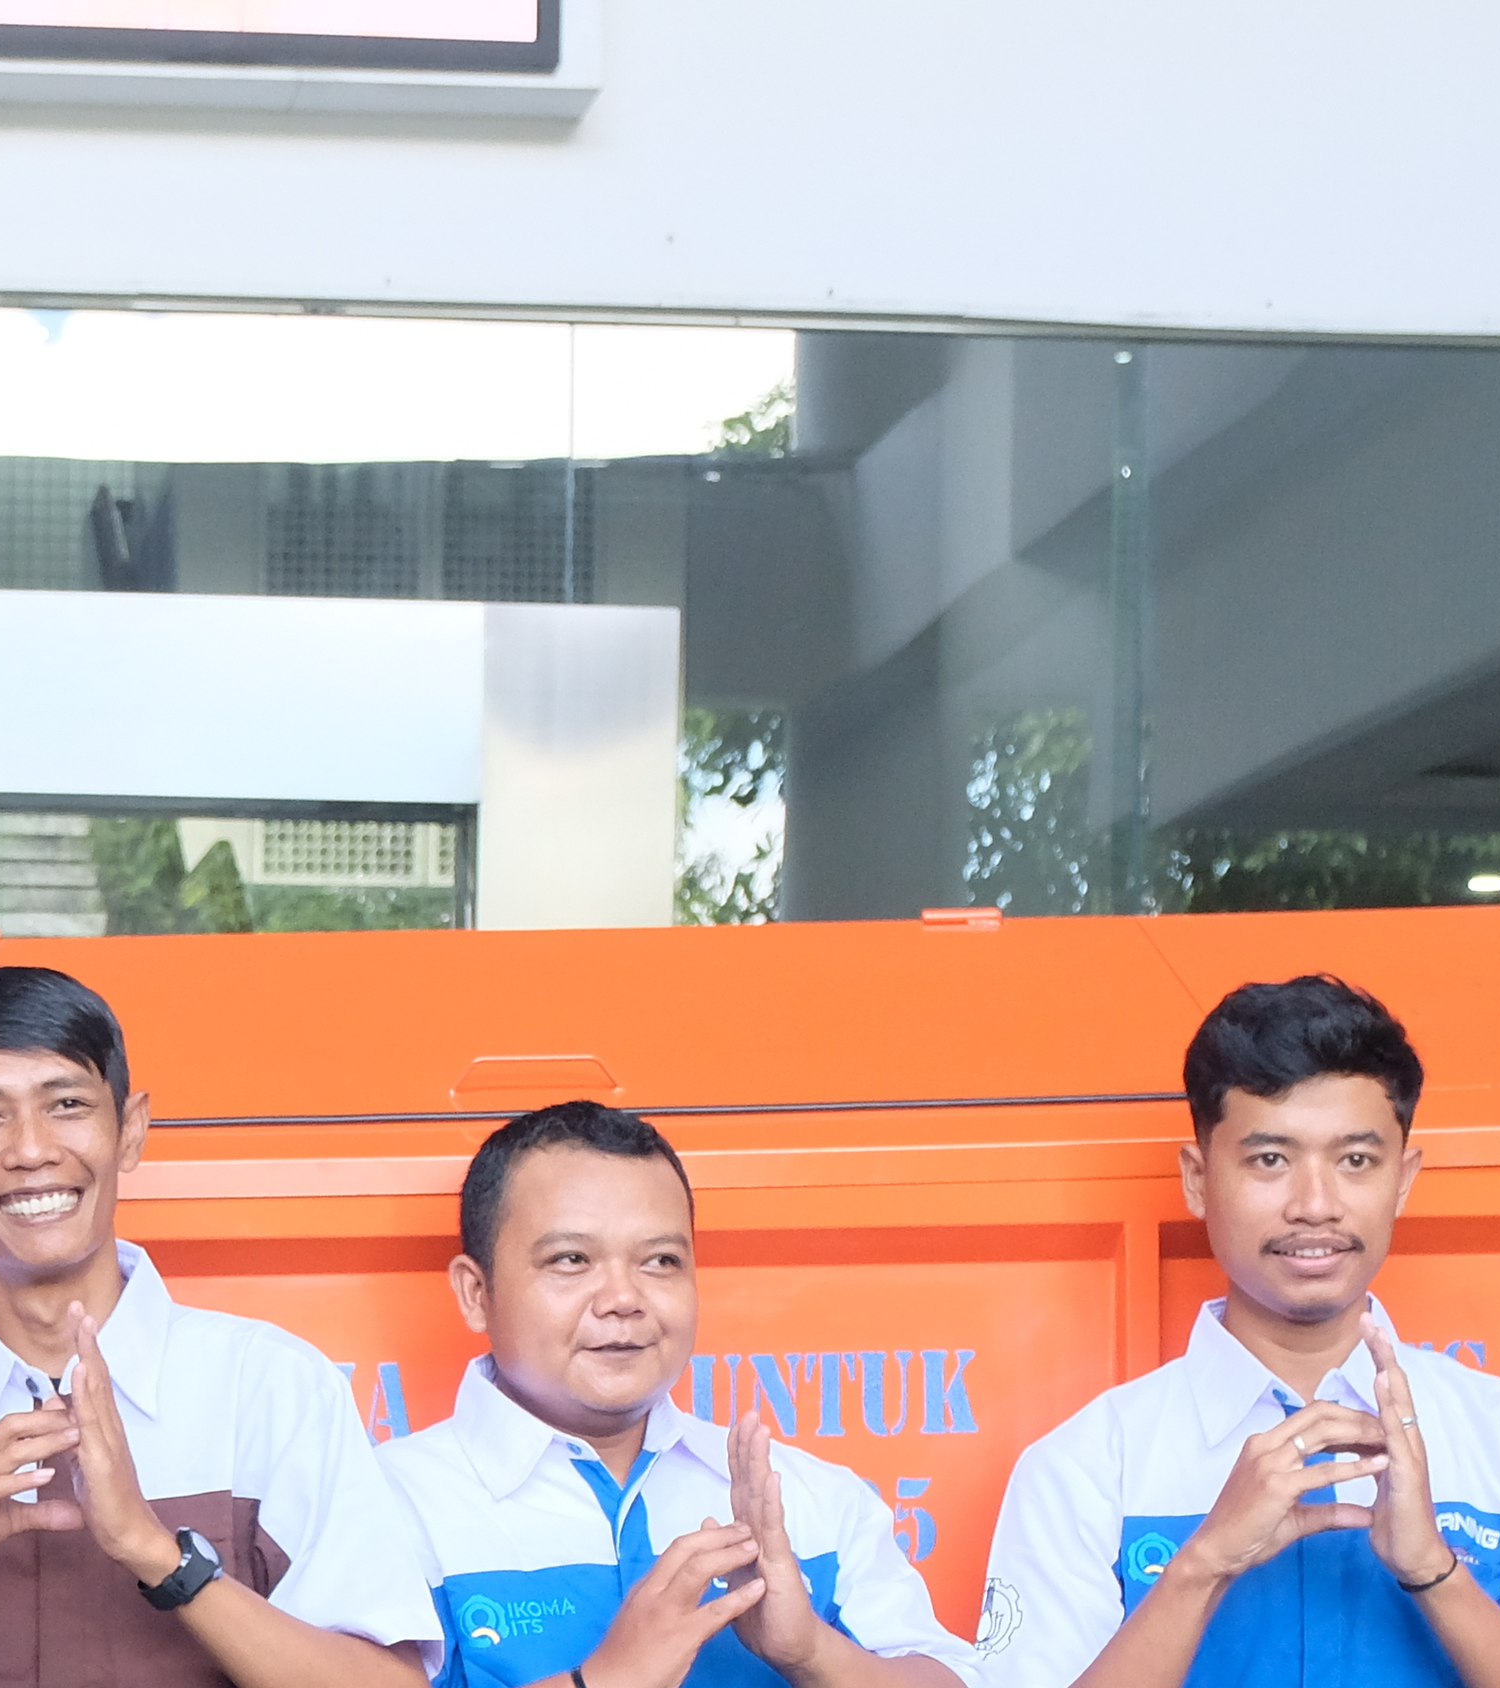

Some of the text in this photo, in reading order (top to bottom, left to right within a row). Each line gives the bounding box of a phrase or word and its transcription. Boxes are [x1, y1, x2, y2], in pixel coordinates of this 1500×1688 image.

[689, 1349, 979, 1437] UNTUK
[506, 1597, 577, 1618] IKOMA
[510, 1618, 545, 1637] ITS
